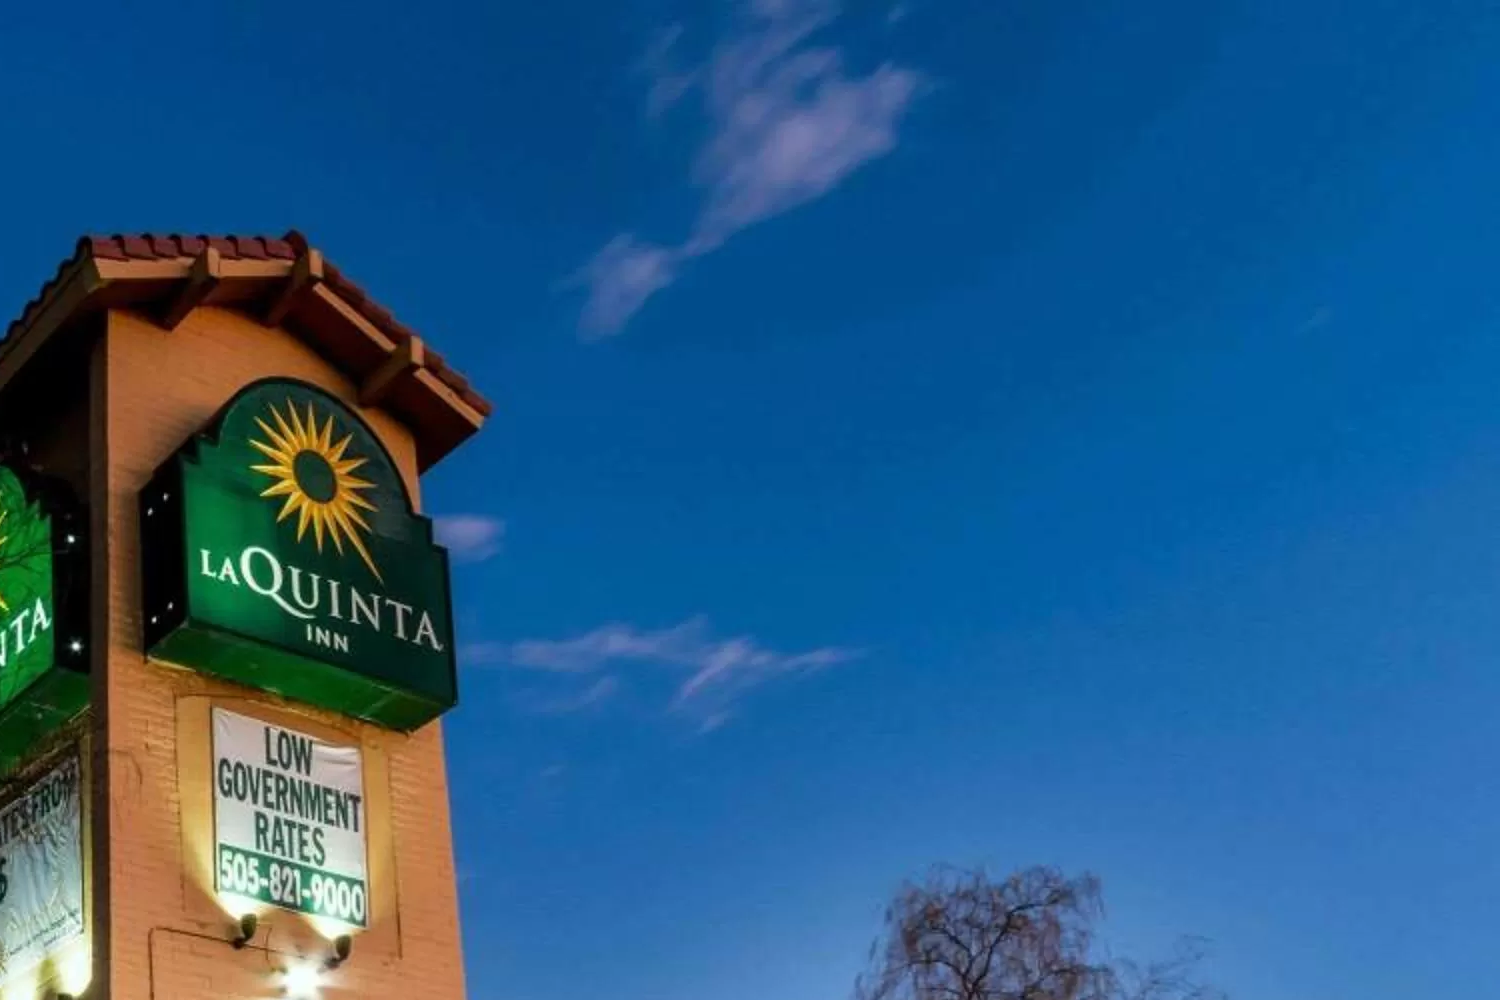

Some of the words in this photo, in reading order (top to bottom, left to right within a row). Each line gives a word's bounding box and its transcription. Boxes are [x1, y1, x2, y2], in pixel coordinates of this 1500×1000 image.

[201, 549, 240, 585] LA
[240, 546, 443, 651] QUINTA
[305, 623, 349, 653] INN
[264, 726, 313, 776] LOW
[217, 757, 361, 832] GOVERNMENT
[255, 811, 326, 868] RATES
[220, 848, 365, 922] 505-821-9000
